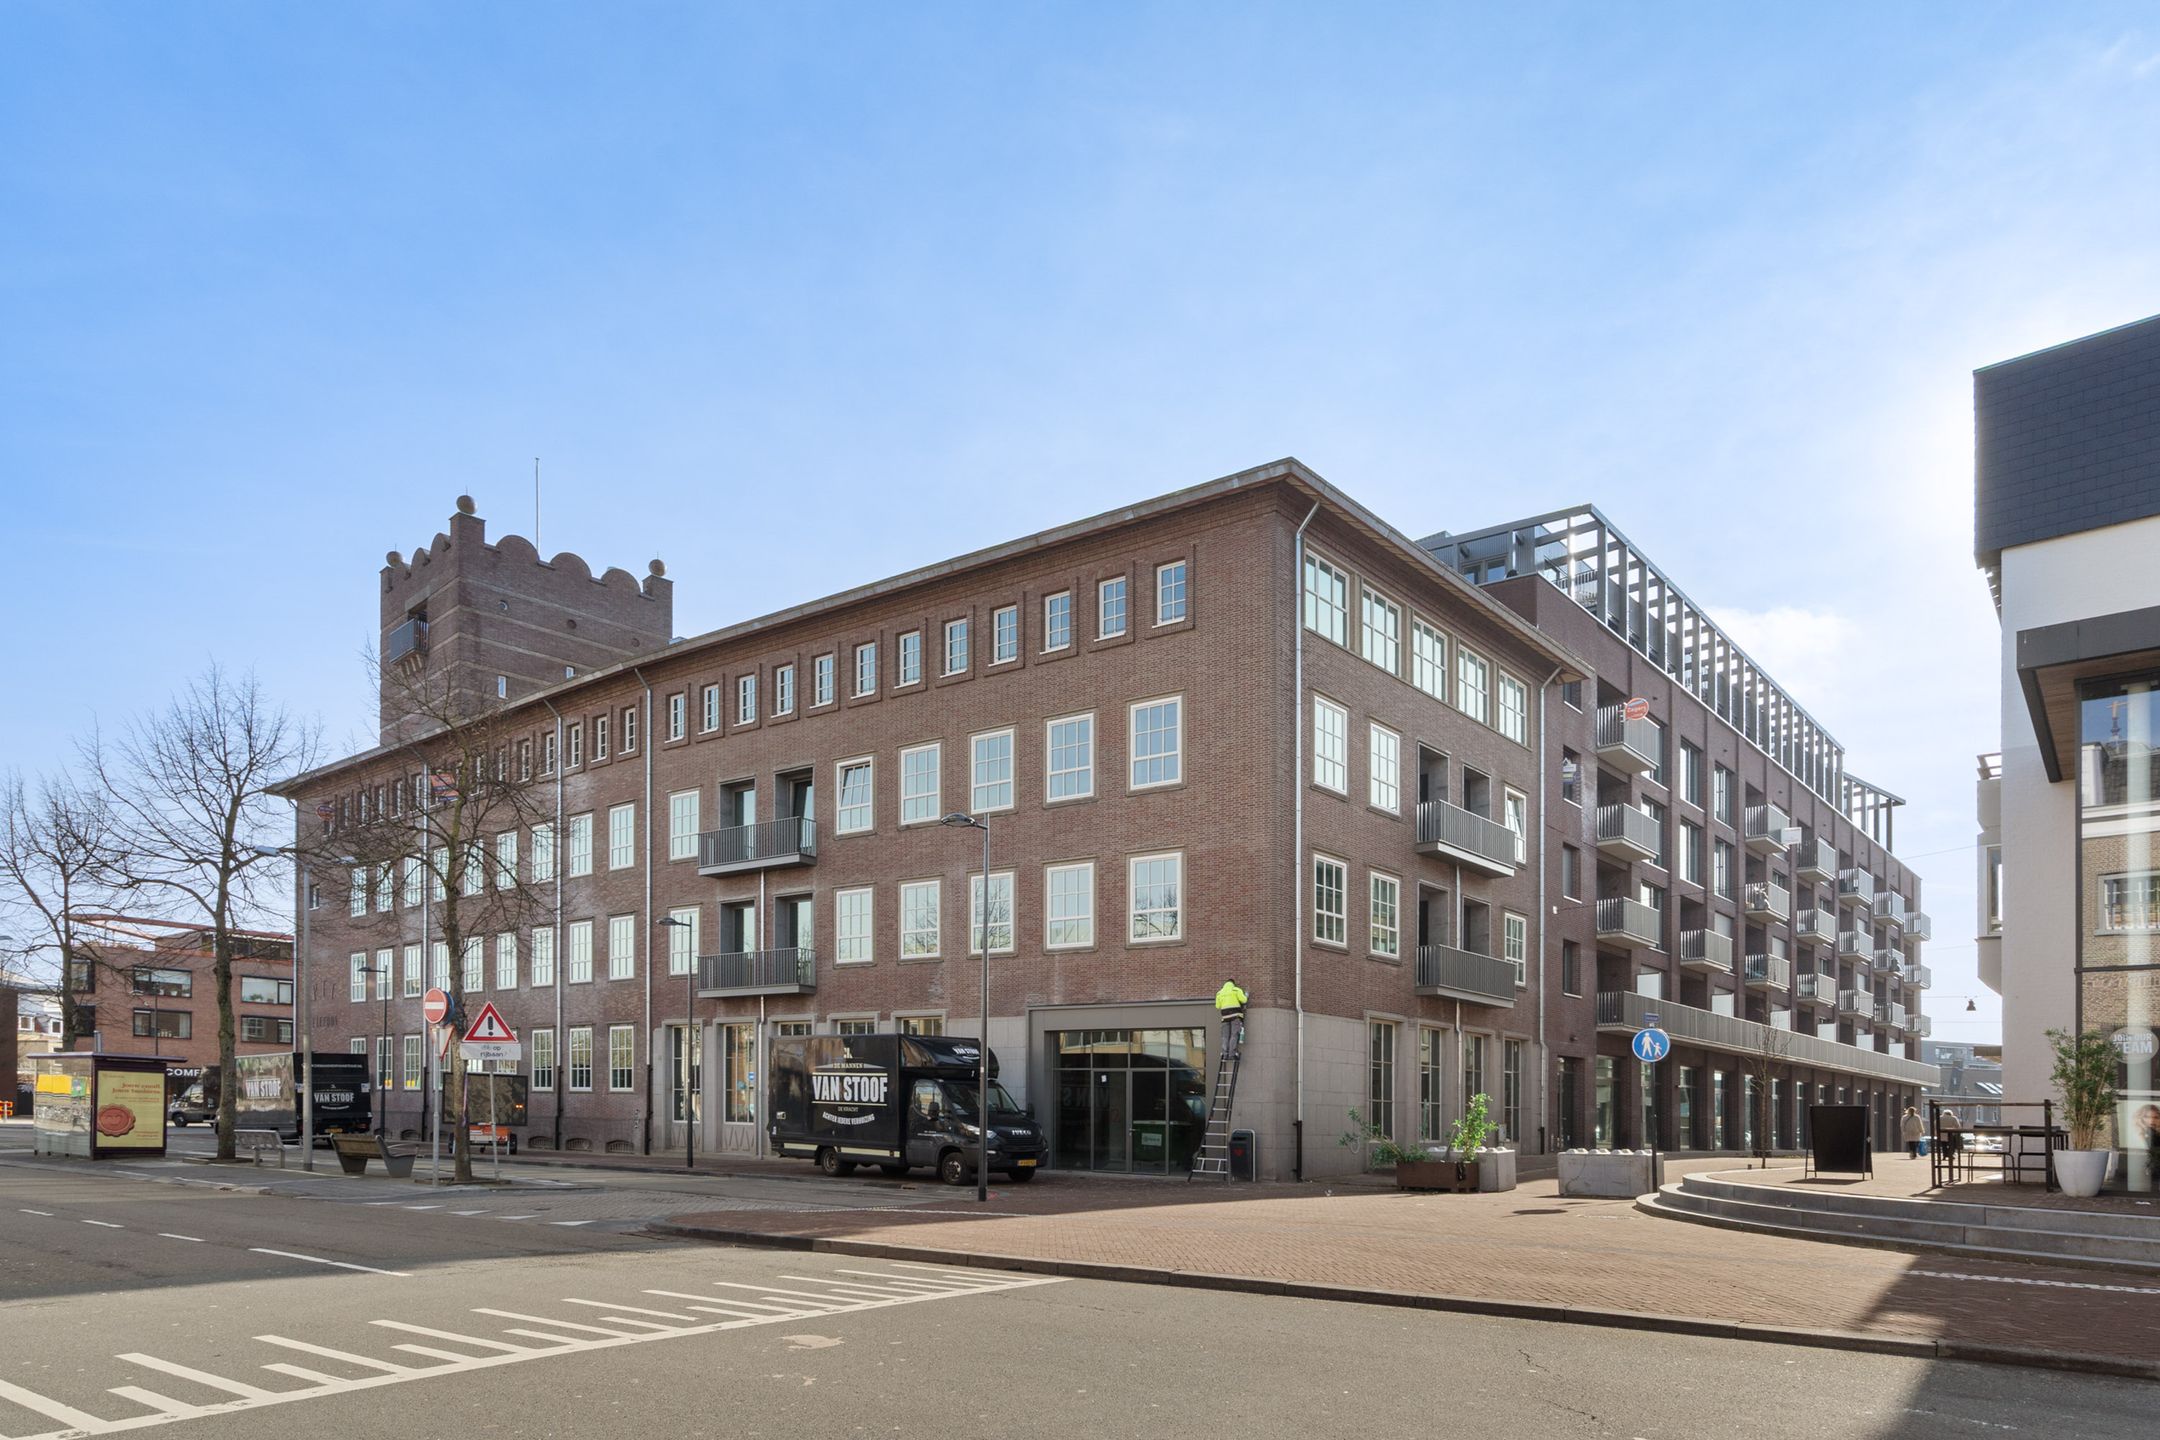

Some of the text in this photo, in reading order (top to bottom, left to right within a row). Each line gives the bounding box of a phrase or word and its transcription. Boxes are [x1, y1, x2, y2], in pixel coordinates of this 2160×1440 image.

[246, 1079, 281, 1097] VAN STOOF
[812, 1076, 888, 1103] VAN STOOF
[314, 1092, 354, 1103] VAN STOOF
